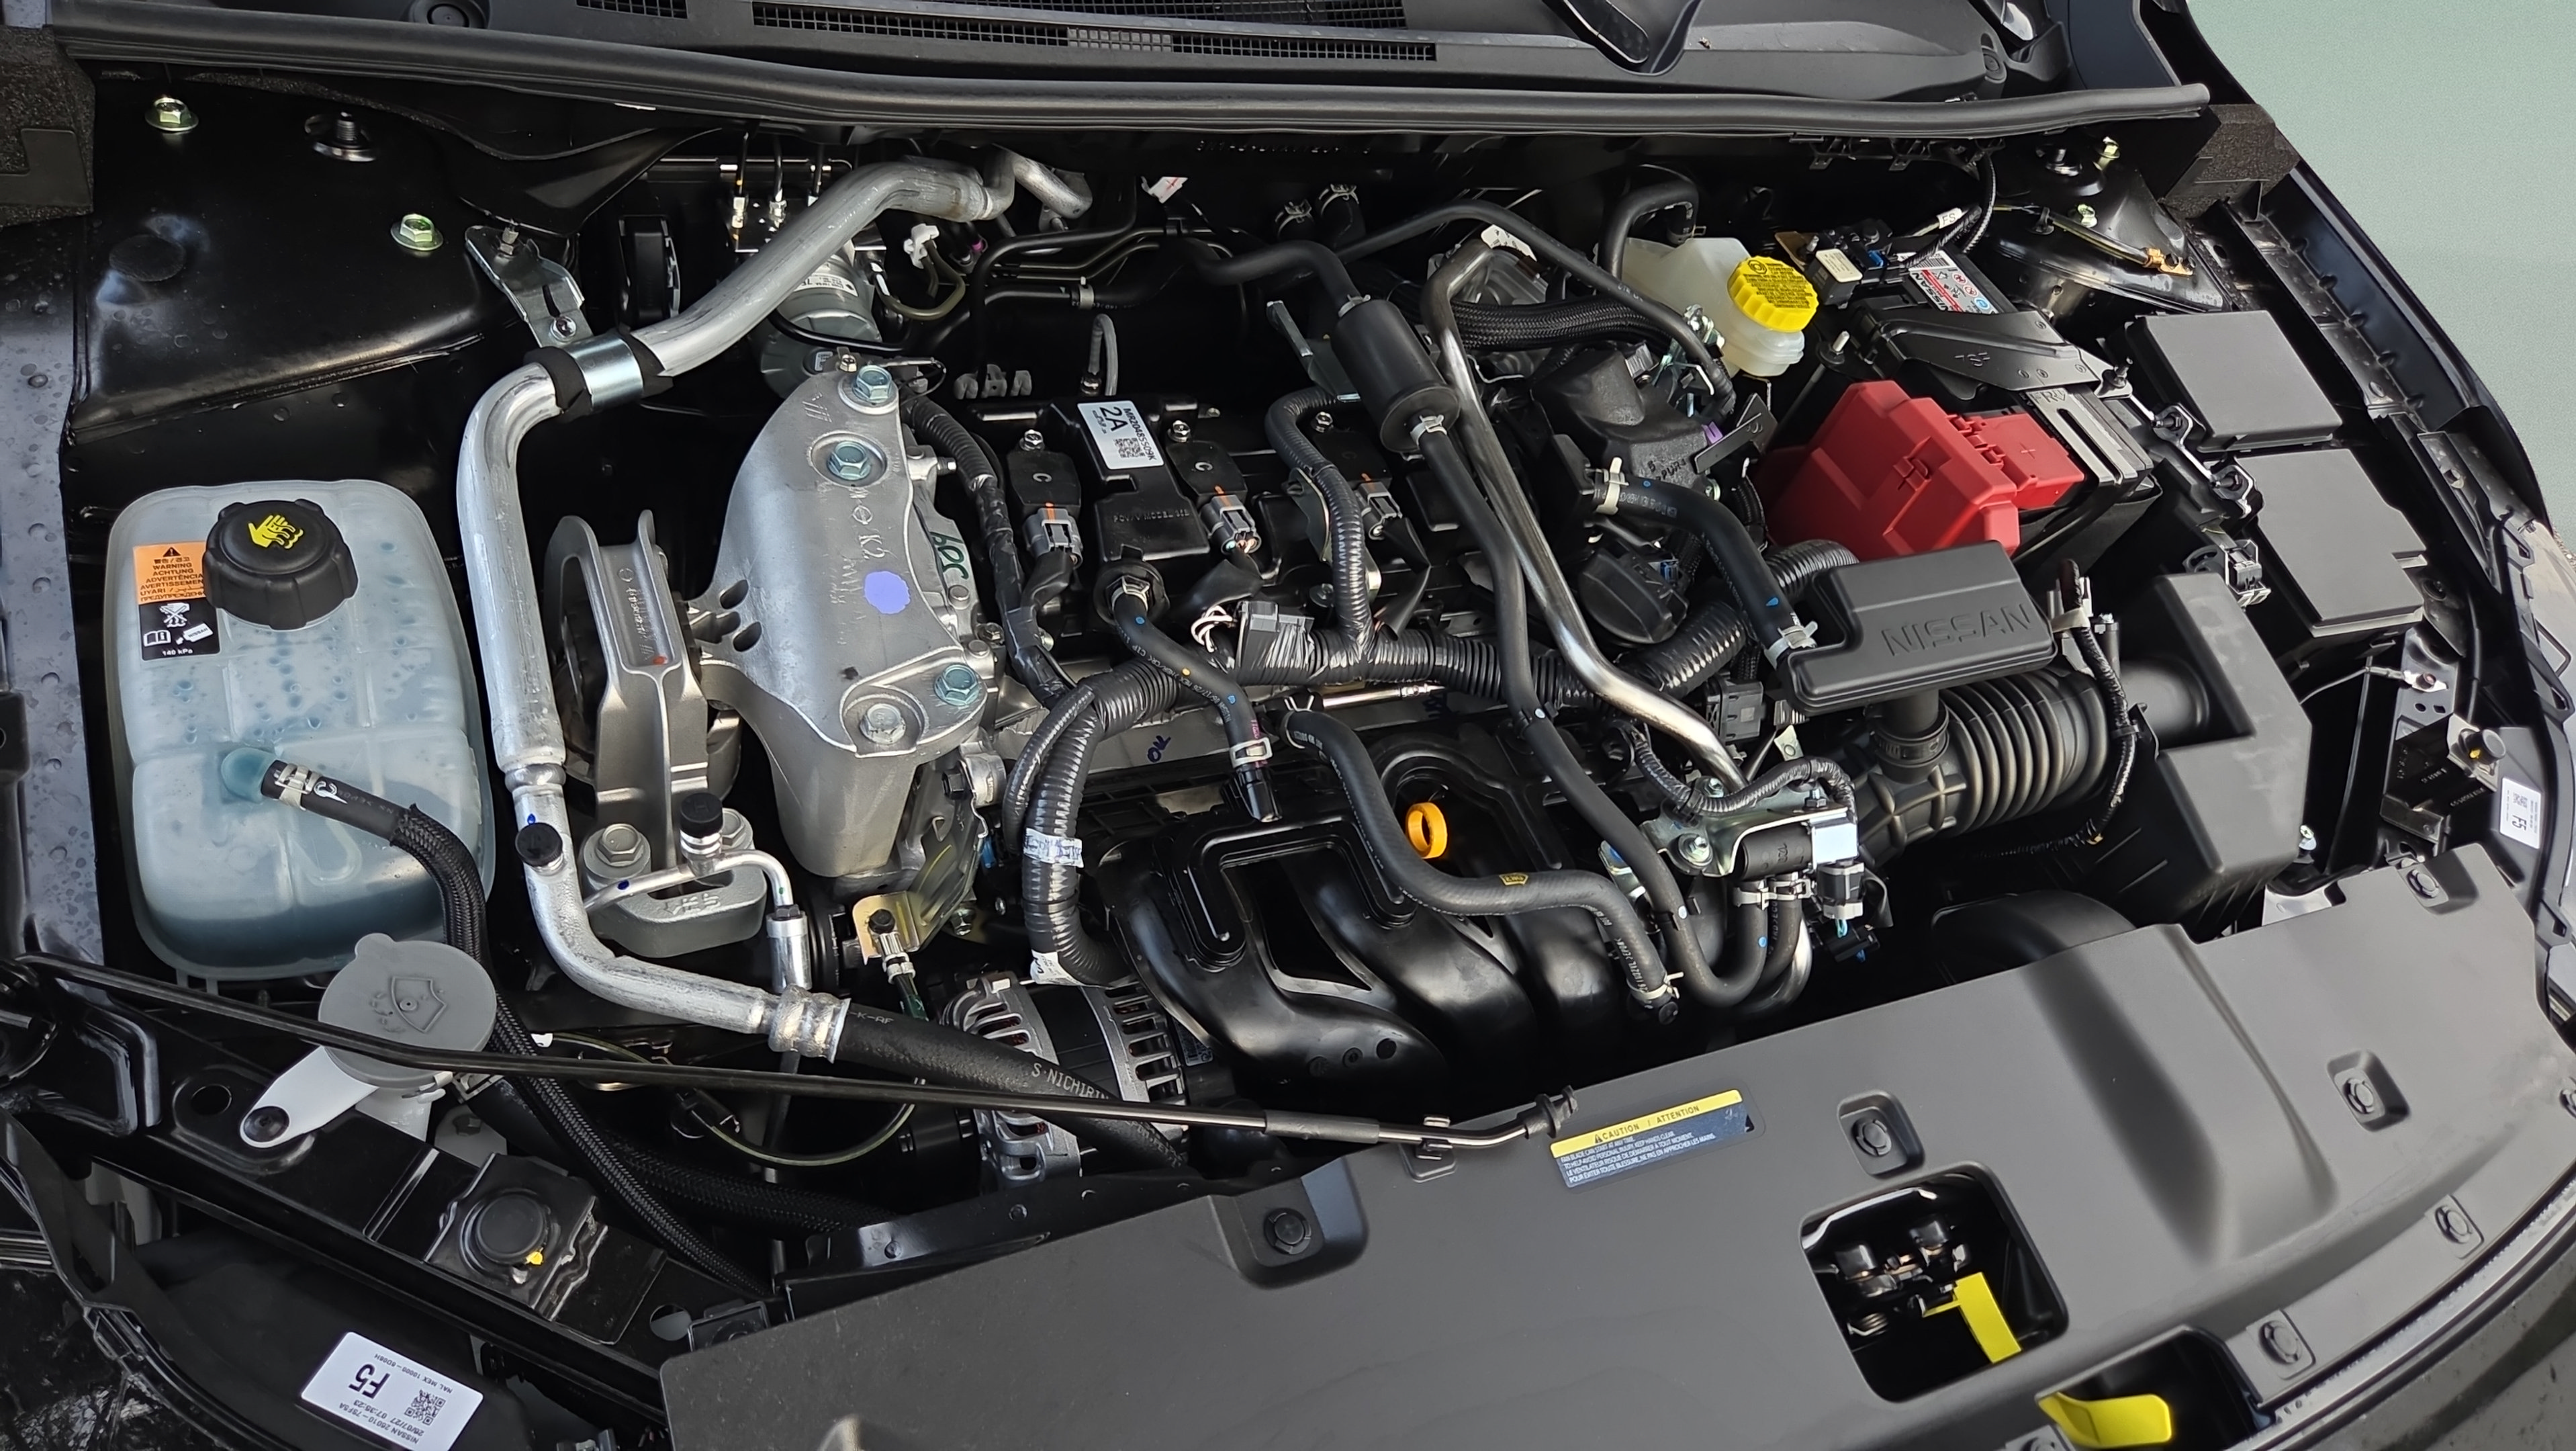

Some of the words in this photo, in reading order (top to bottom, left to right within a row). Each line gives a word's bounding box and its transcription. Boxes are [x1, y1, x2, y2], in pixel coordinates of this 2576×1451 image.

[1941, 212, 1957, 226] FS
[1099, 406, 1128, 431] 2A
[152, 568, 194, 576] ACHTUNG
[140, 580, 203, 590] AVERTISSEMEN
[140, 588, 166, 597] UYARI
[1881, 603, 2030, 656] NISSAN
[2512, 814, 2527, 831] F5
[1602, 1124, 1639, 1139] CAUTION
[1655, 1105, 1700, 1123] ATTENTION
[348, 1364, 390, 1399] F5
[422, 1376, 437, 1387] MEX
[439, 1383, 453, 1394] NAL
[391, 1428, 420, 1444] NISSAN
